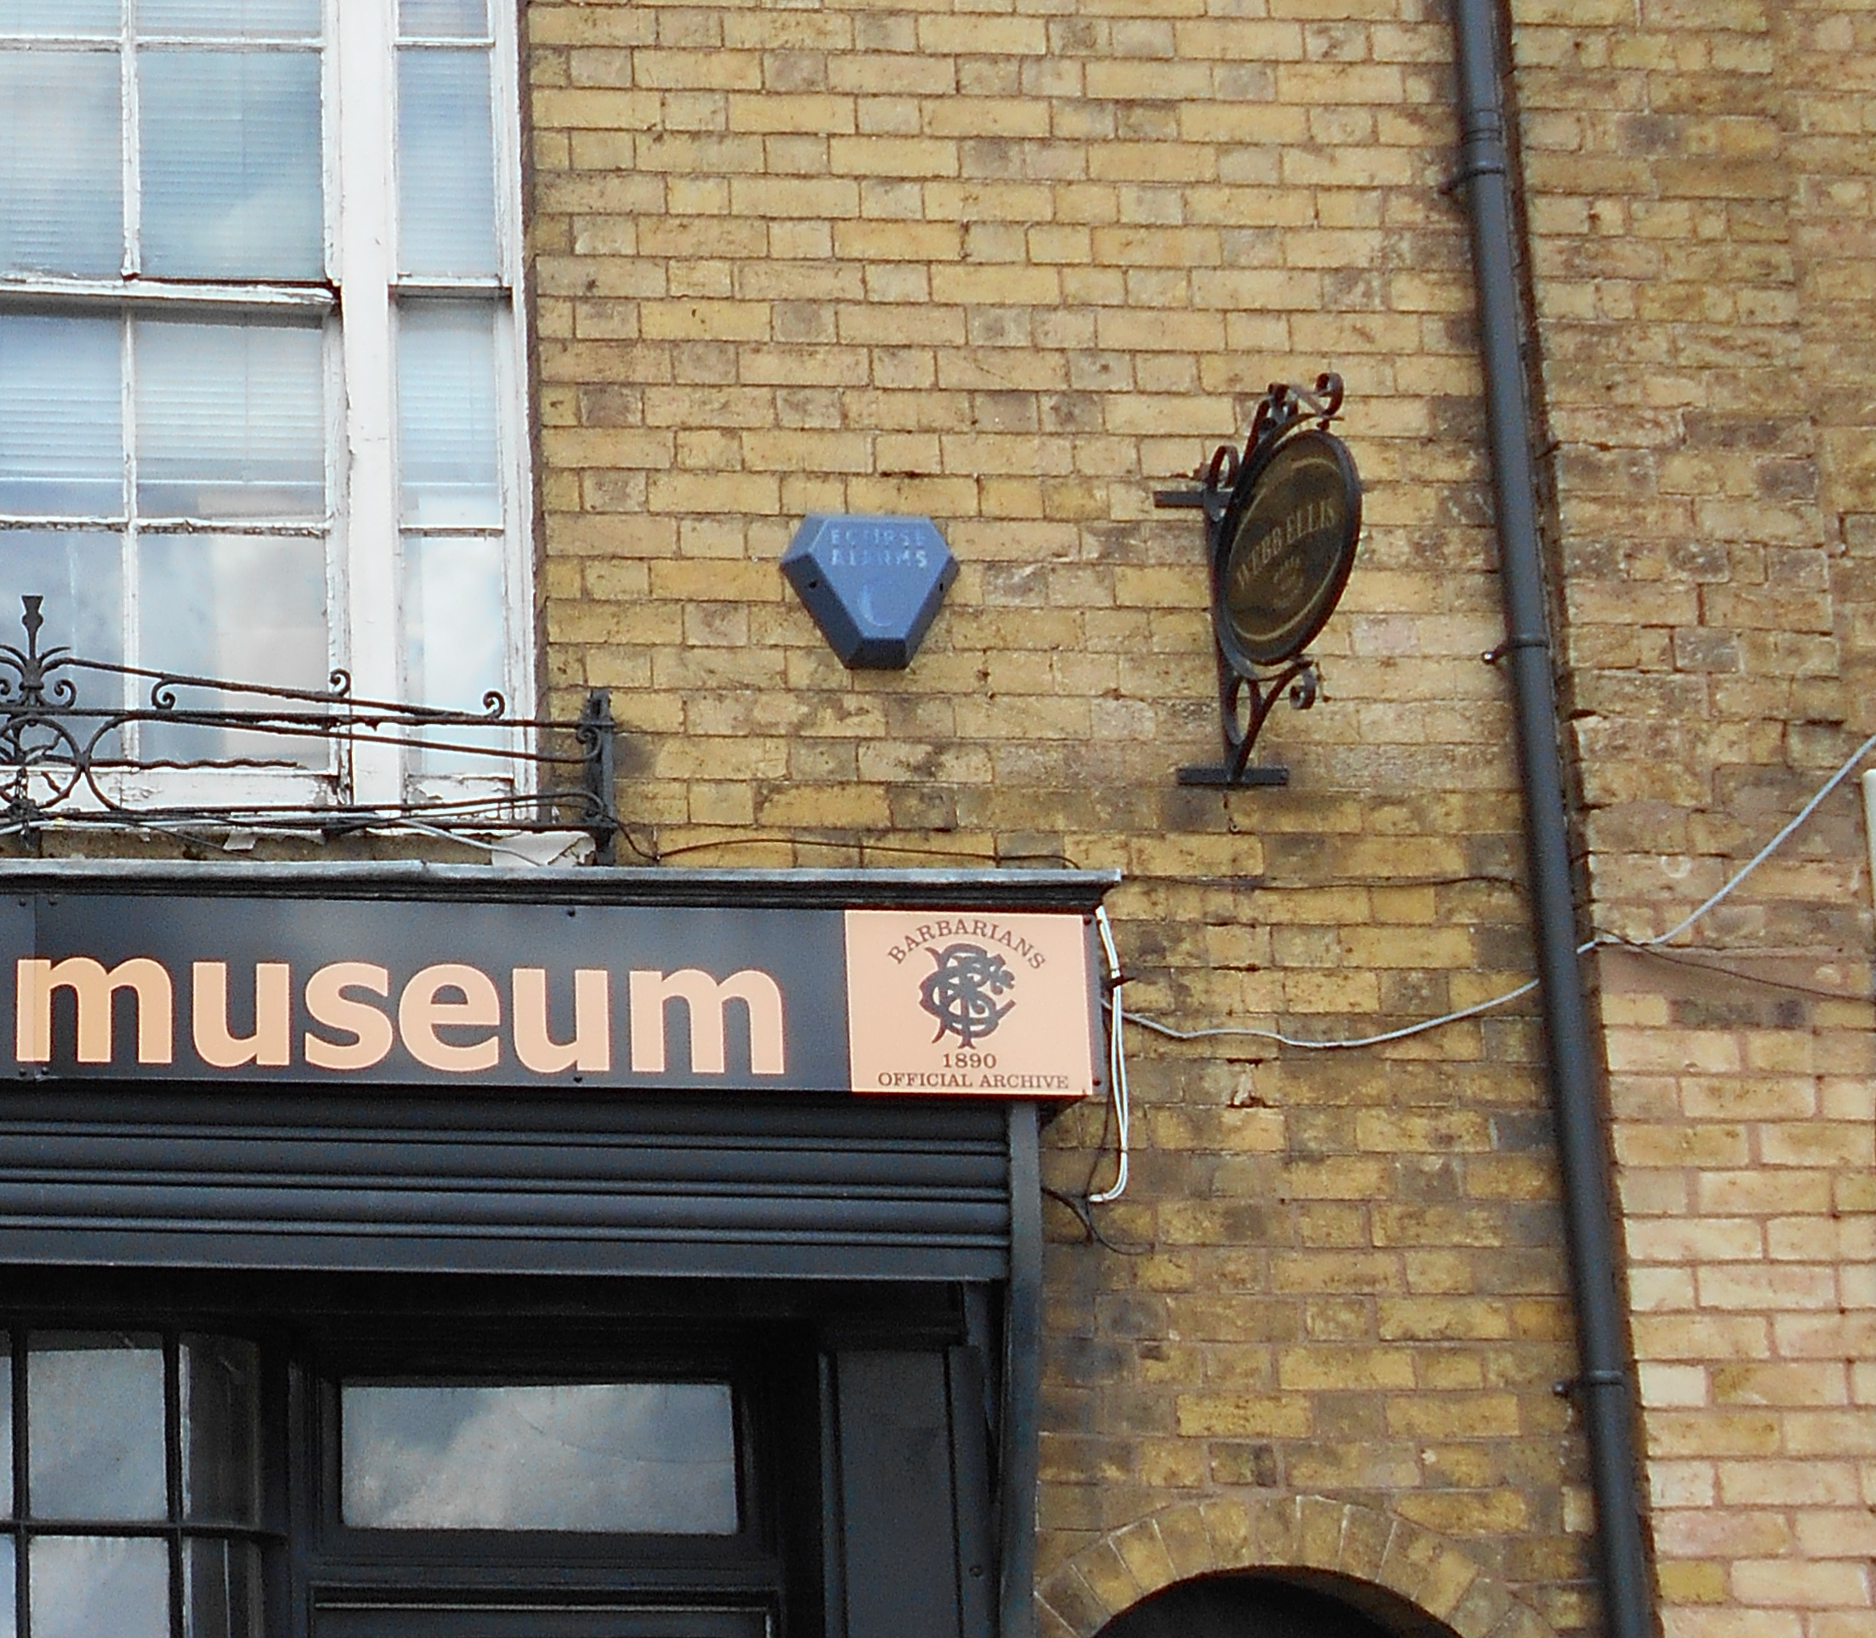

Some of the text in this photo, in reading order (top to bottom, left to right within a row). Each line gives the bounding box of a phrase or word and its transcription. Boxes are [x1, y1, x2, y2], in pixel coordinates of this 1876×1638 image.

[1236, 498, 1337, 591] WEBB ELLIS
[887, 918, 1046, 970] BARBARIANS
[15, 956, 786, 1076] museum
[877, 1072, 1069, 1089] OFFICIAL ARCHIVE
[943, 1052, 997, 1069] 1890
